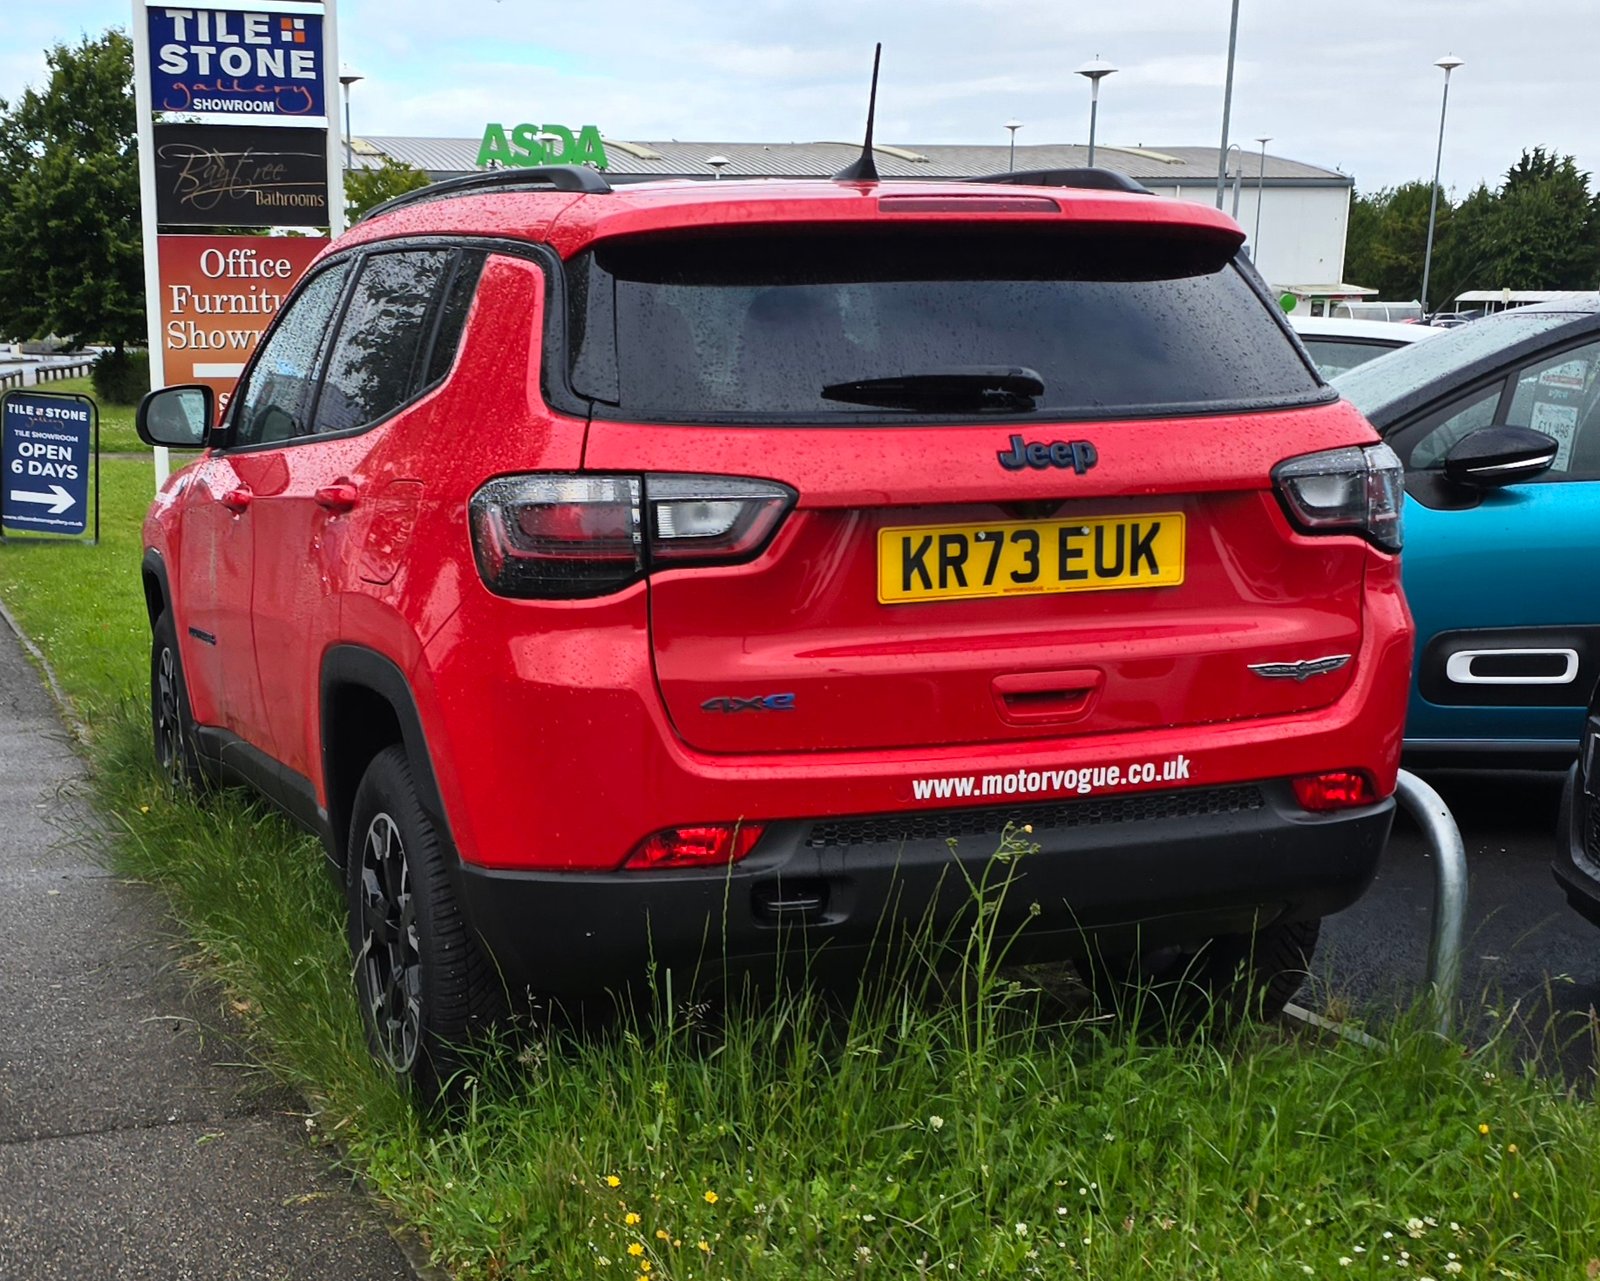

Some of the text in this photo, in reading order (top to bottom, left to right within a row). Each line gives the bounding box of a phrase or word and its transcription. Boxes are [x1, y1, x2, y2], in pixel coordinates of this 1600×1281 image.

[165, 10, 272, 44] TILE
[158, 44, 316, 79] STONE
[163, 79, 313, 113] gallery
[193, 98, 275, 112] SHOWROOM
[476, 123, 609, 168] ASDA
[255, 190, 325, 207] Bathrooms
[200, 249, 292, 278] Office
[7, 403, 87, 421] TILE STONE
[14, 429, 78, 442] TILE SHOWROOM
[18, 442, 72, 461] OPEN
[997, 434, 1098, 474] Jeep
[11, 459, 79, 480] 6 DAYS
[902, 522, 1161, 592] KR73 EUK
[912, 754, 1190, 800] www.motorvogue.co.uk
